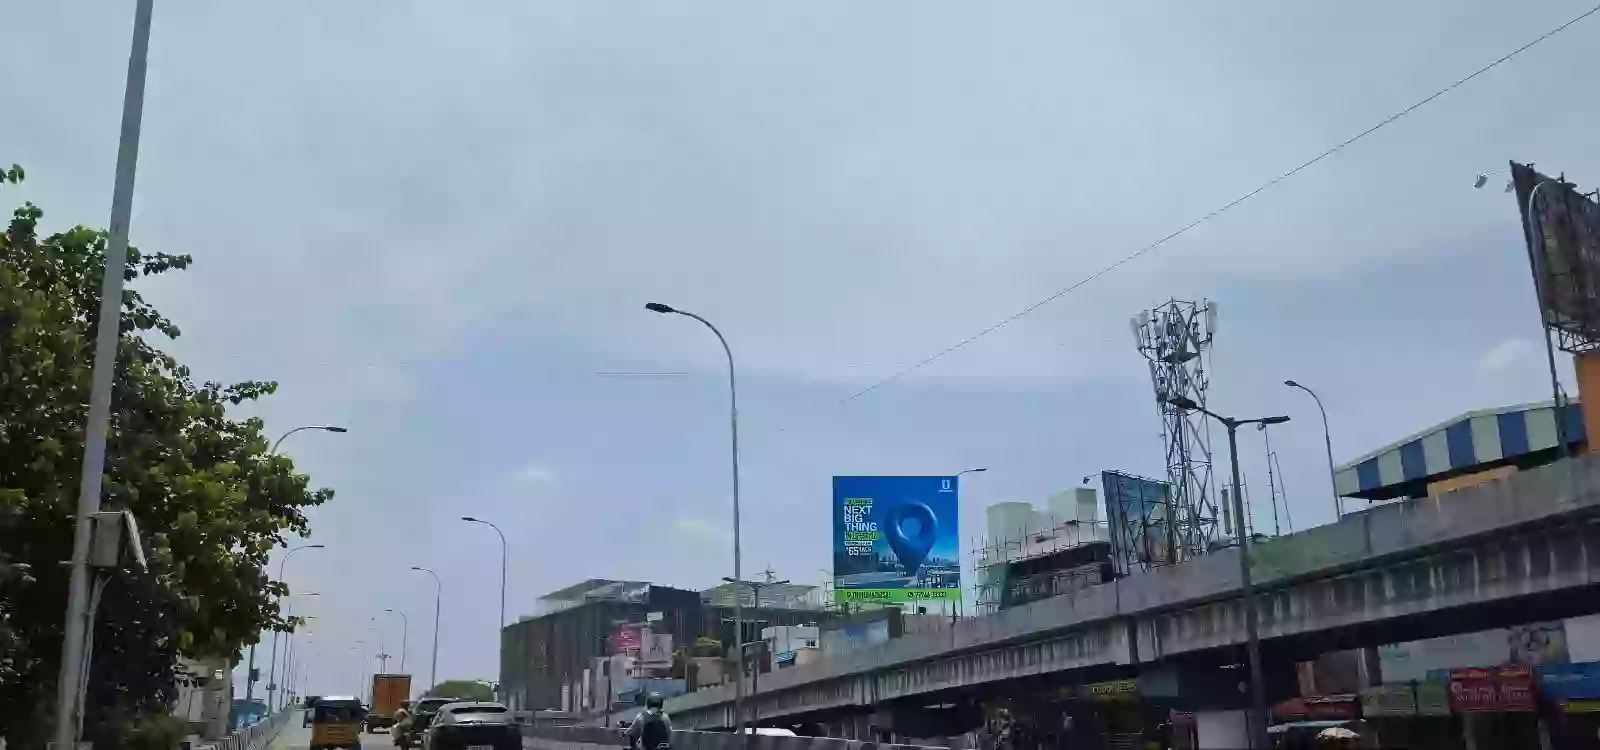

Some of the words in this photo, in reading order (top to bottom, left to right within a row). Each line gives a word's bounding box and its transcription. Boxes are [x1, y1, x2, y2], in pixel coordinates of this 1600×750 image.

[844, 505, 872, 514] NEXT
[844, 514, 863, 522] BIG
[844, 522, 877, 531] THING
